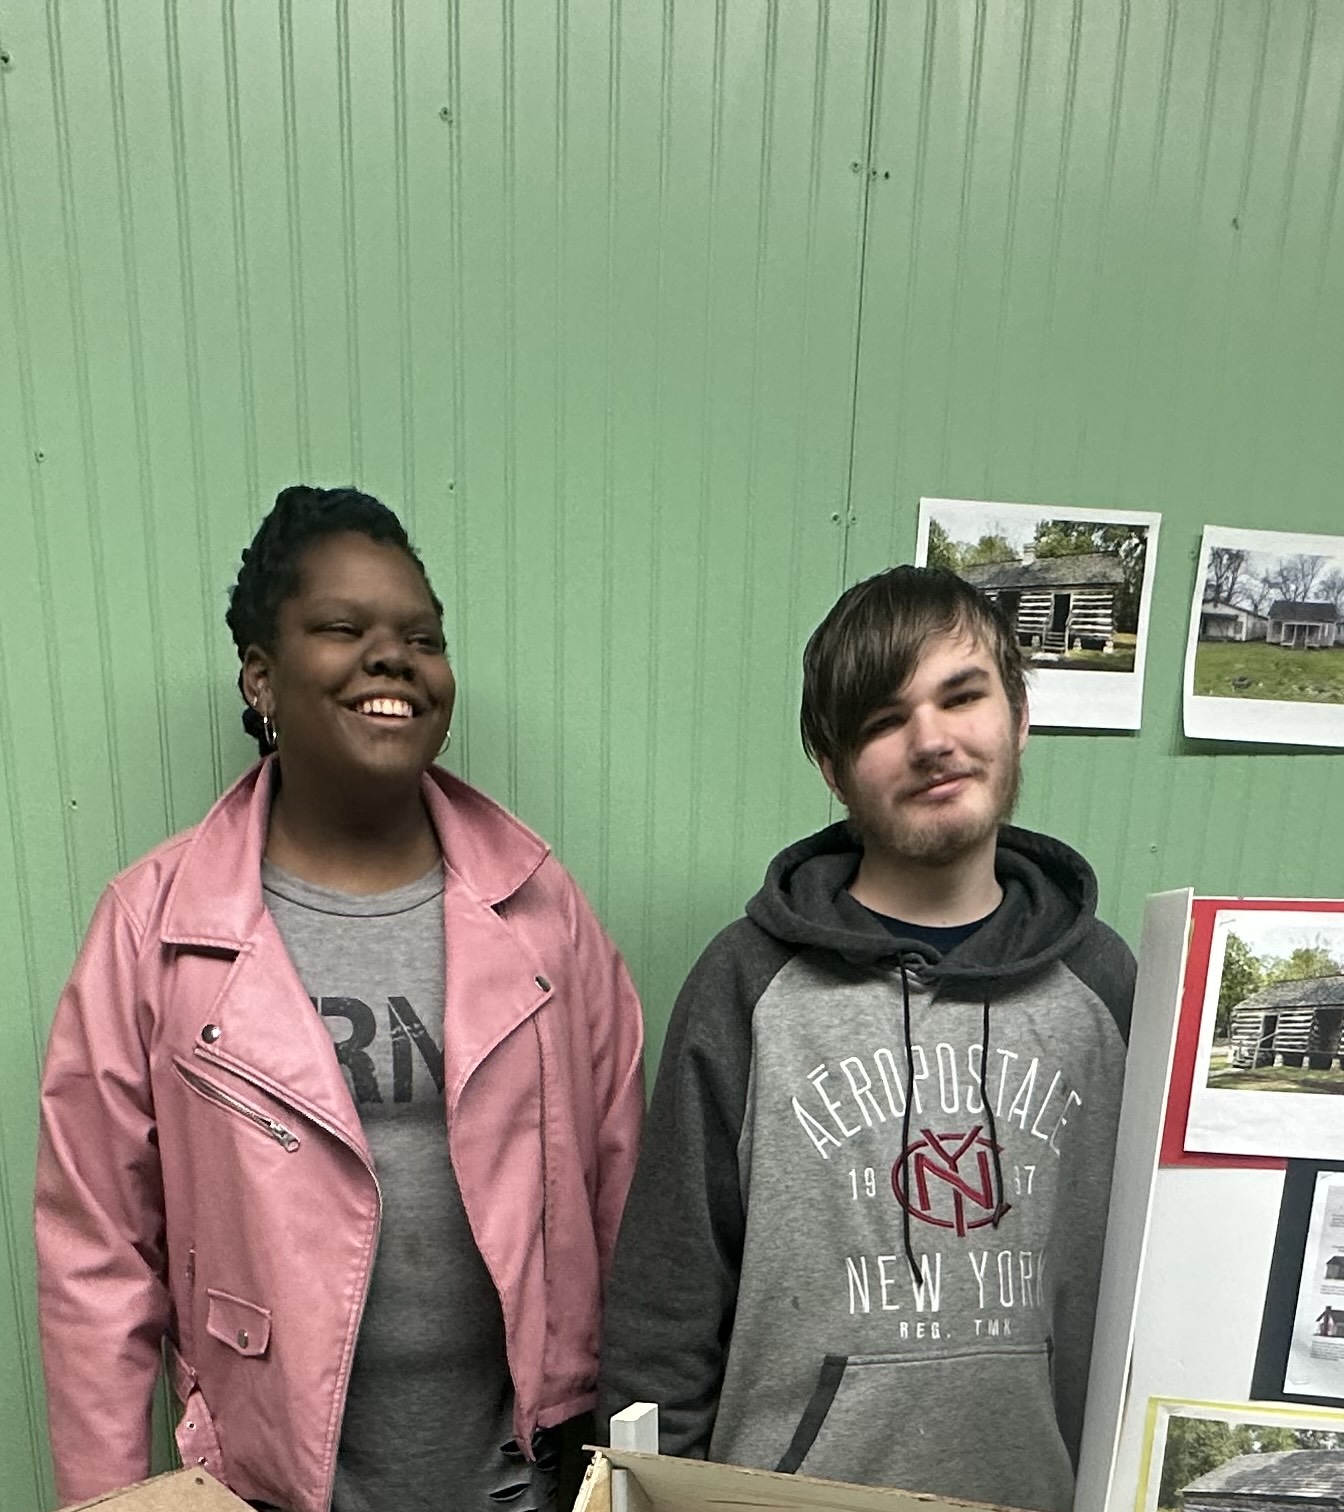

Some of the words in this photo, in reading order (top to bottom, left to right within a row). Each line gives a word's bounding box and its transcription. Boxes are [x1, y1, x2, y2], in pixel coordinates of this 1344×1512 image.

[848, 1166, 877, 1201] 19
[845, 1251, 943, 1315] NEW
[899, 1320, 953, 1340] REG.
